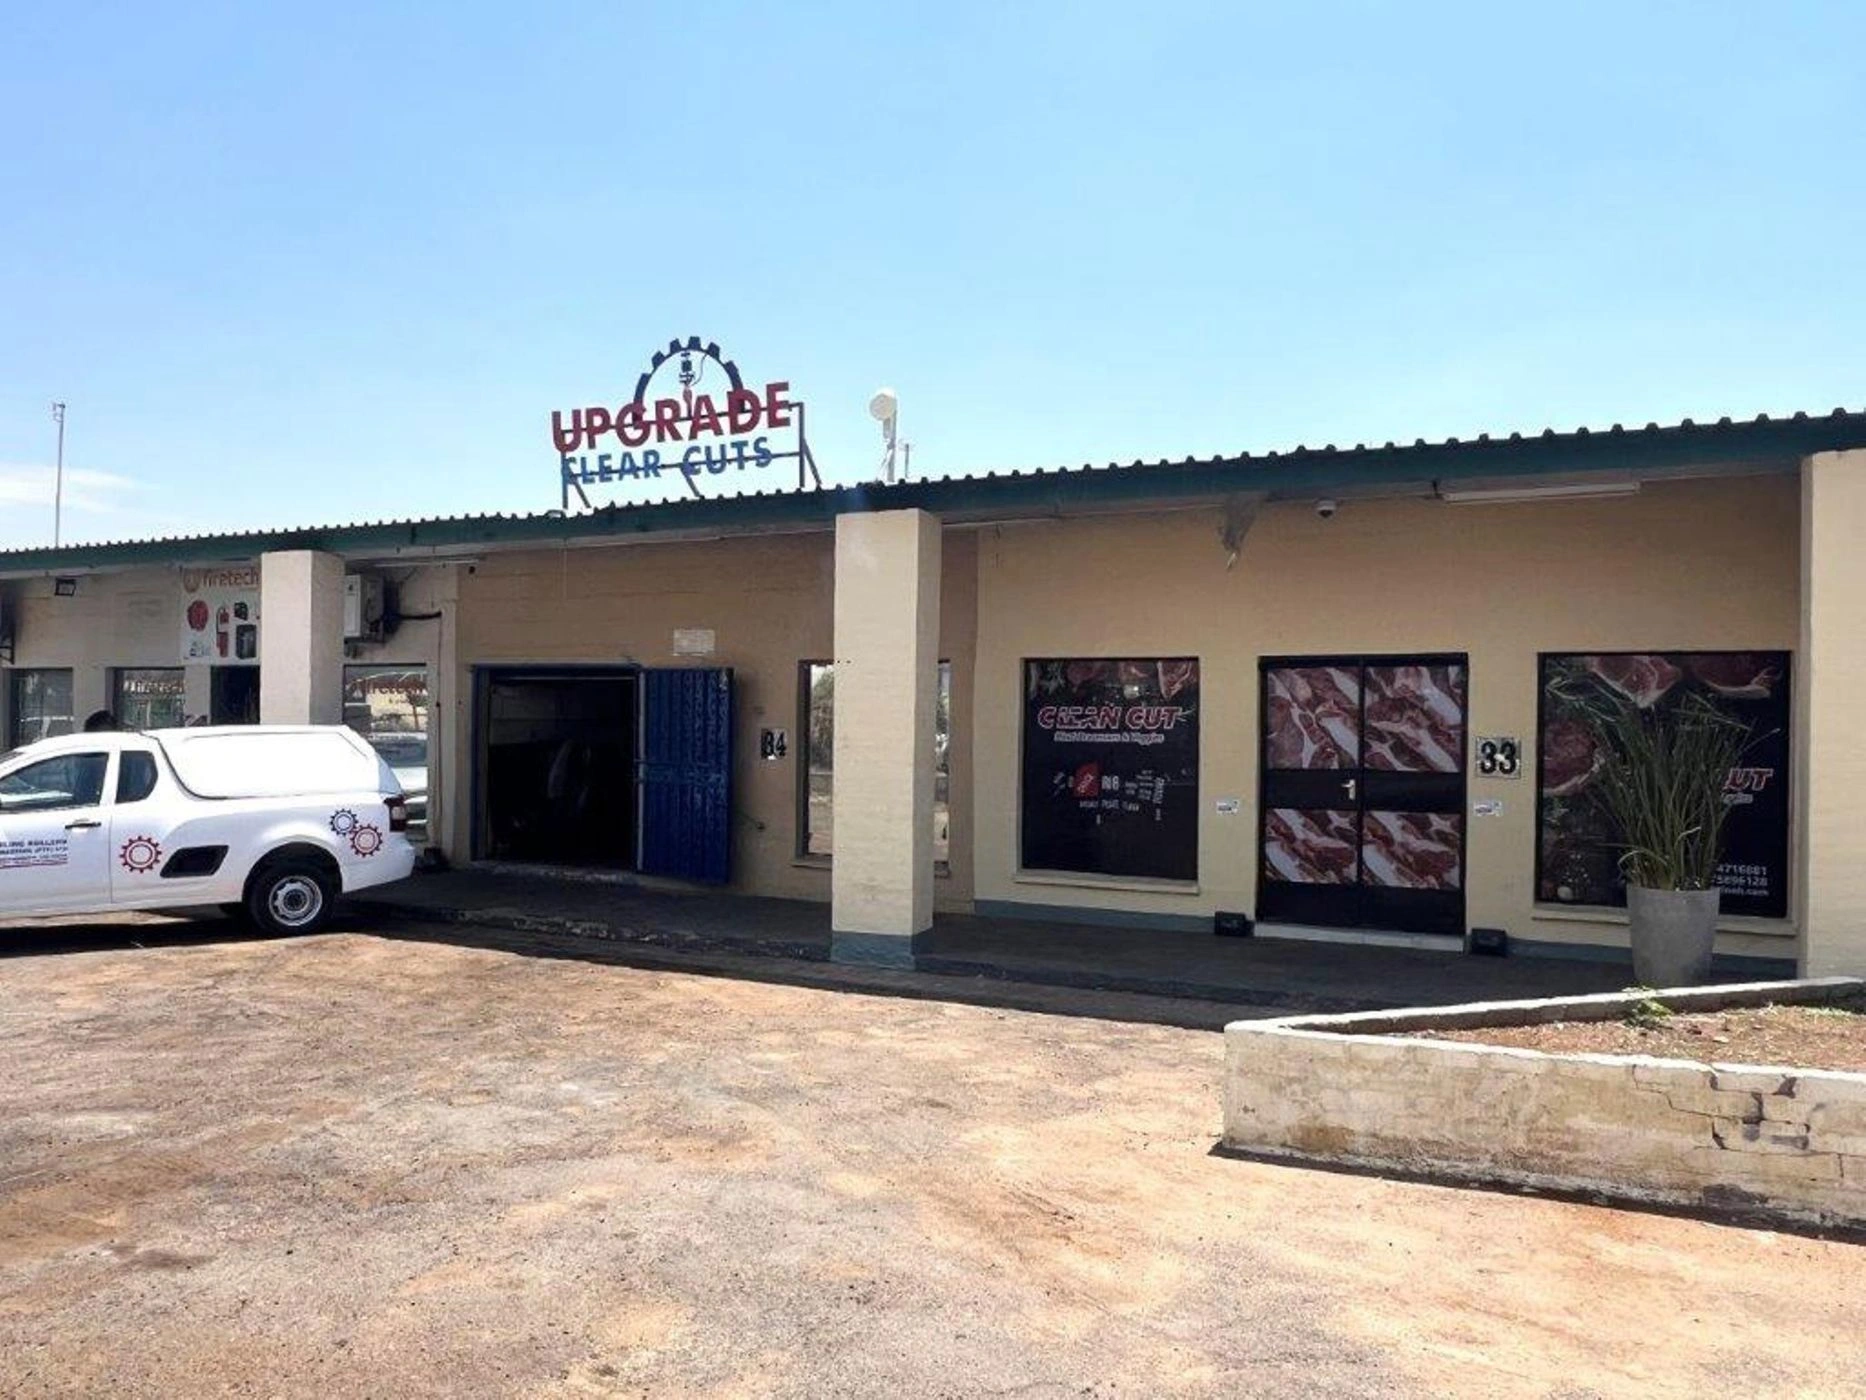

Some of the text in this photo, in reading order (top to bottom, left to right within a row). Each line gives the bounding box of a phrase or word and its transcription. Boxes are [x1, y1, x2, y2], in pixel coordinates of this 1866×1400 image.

[551, 381, 791, 453] UPGRADE
[563, 436, 773, 485] CLEAR CUTS
[203, 567, 260, 588] firetech
[1038, 706, 1182, 729] CLEAN CUT
[1480, 741, 1516, 775] 33
[1722, 768, 1774, 792] UT
